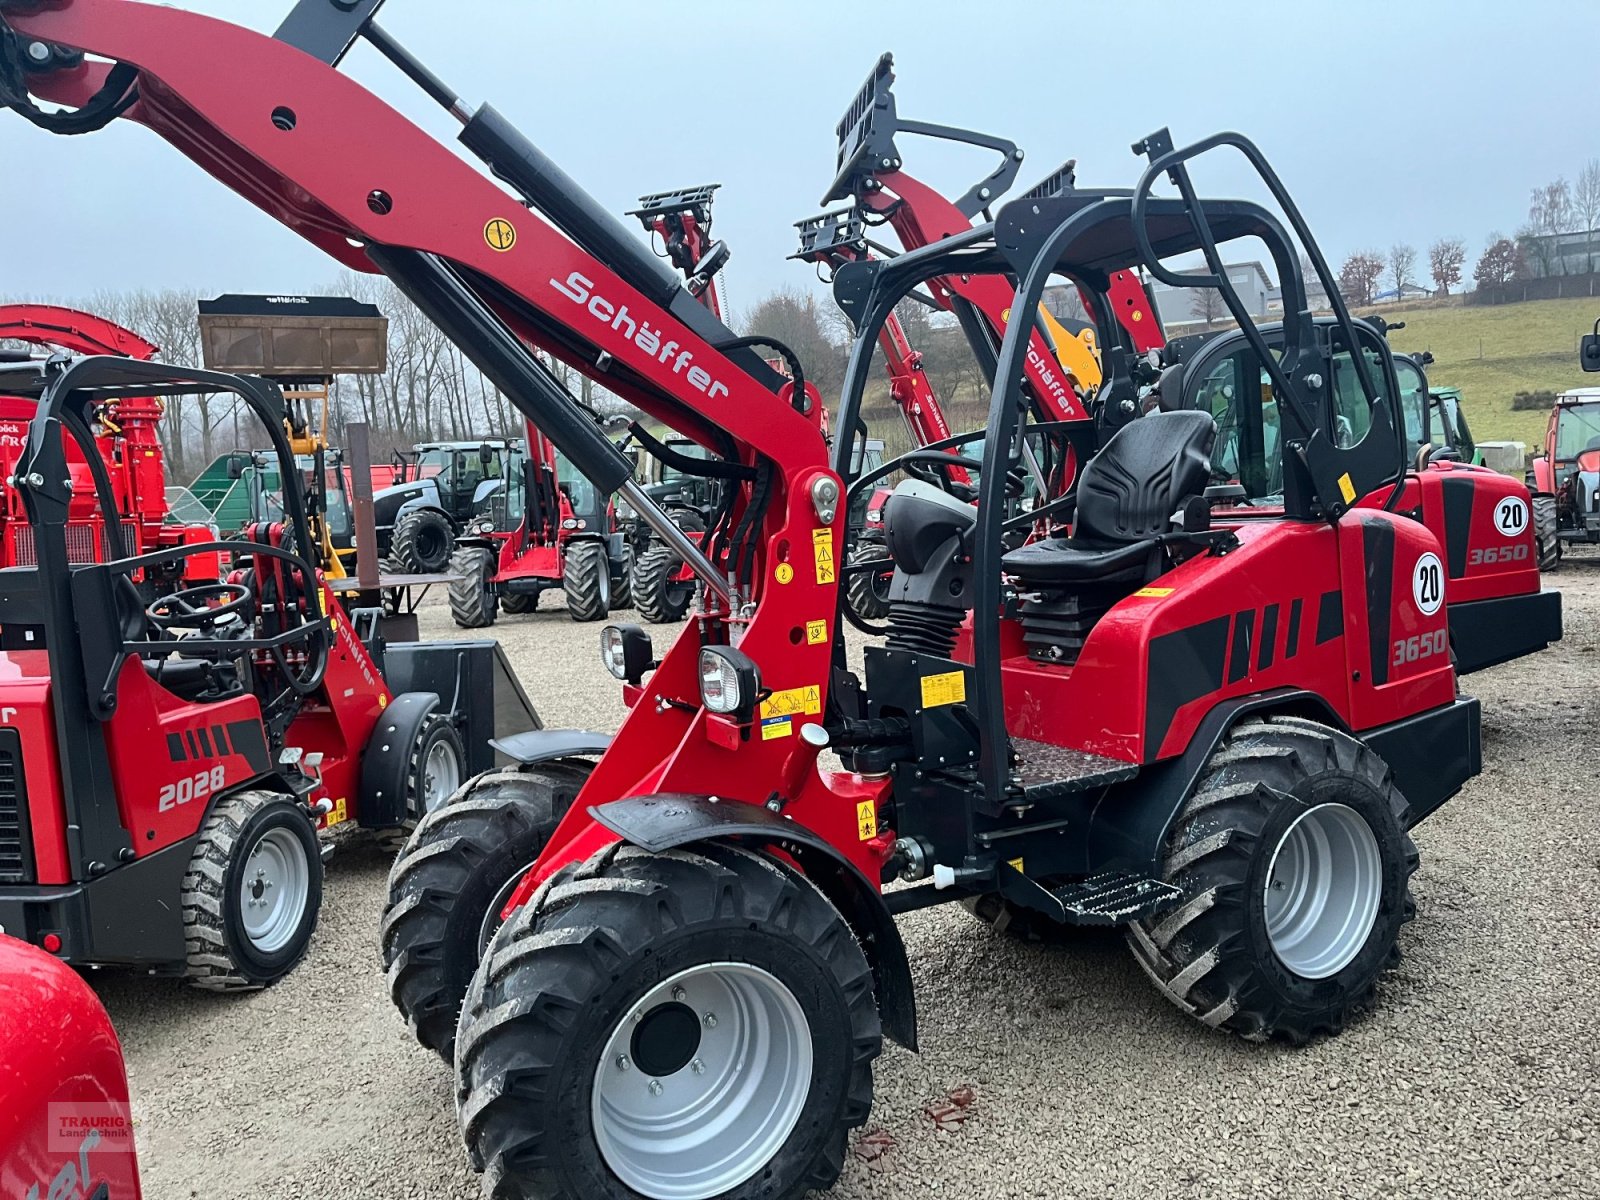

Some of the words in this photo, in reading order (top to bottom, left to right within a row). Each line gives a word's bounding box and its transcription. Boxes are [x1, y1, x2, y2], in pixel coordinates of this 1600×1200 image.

[549, 271, 729, 400] Schäffer
[1501, 503, 1522, 529] 20
[1468, 544, 1528, 566] 3650
[1419, 564, 1440, 604] 20
[336, 612, 375, 686] Schäffer
[1392, 628, 1446, 667] 3650
[159, 765, 225, 813] 2028
